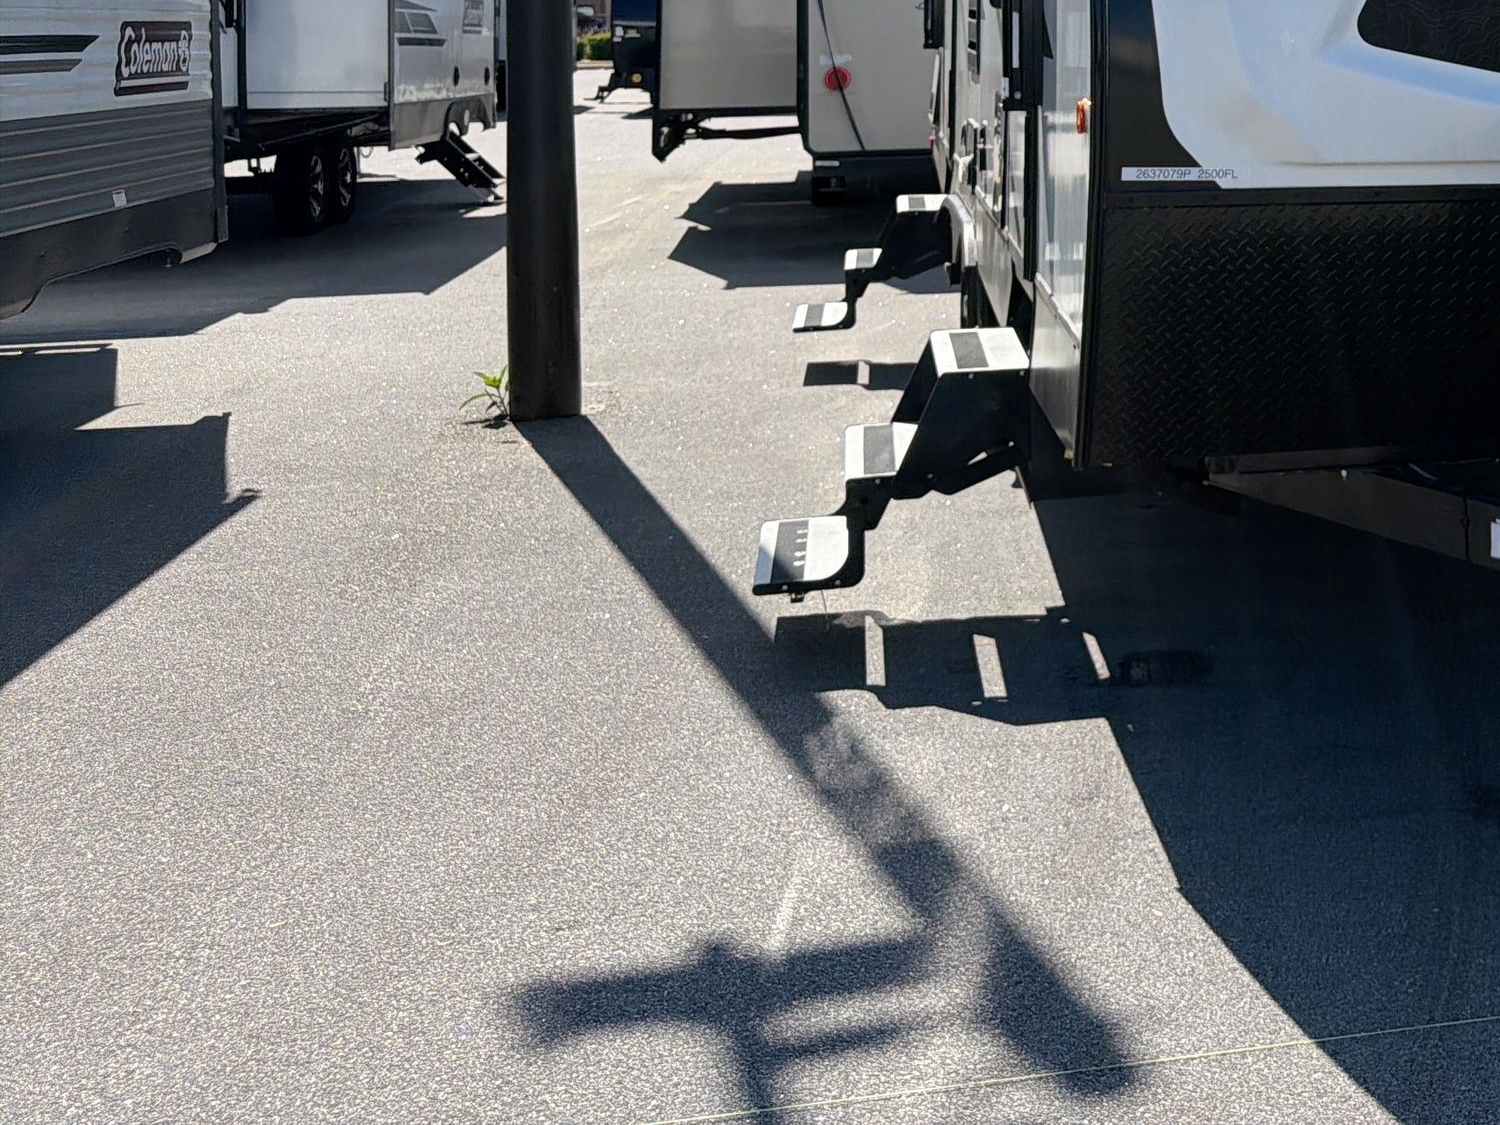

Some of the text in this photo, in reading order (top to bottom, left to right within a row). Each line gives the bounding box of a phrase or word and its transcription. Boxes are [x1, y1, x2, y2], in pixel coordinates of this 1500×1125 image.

[121, 26, 178, 78] Coleman
[1136, 168, 1238, 179] 2637079P 2500FL
